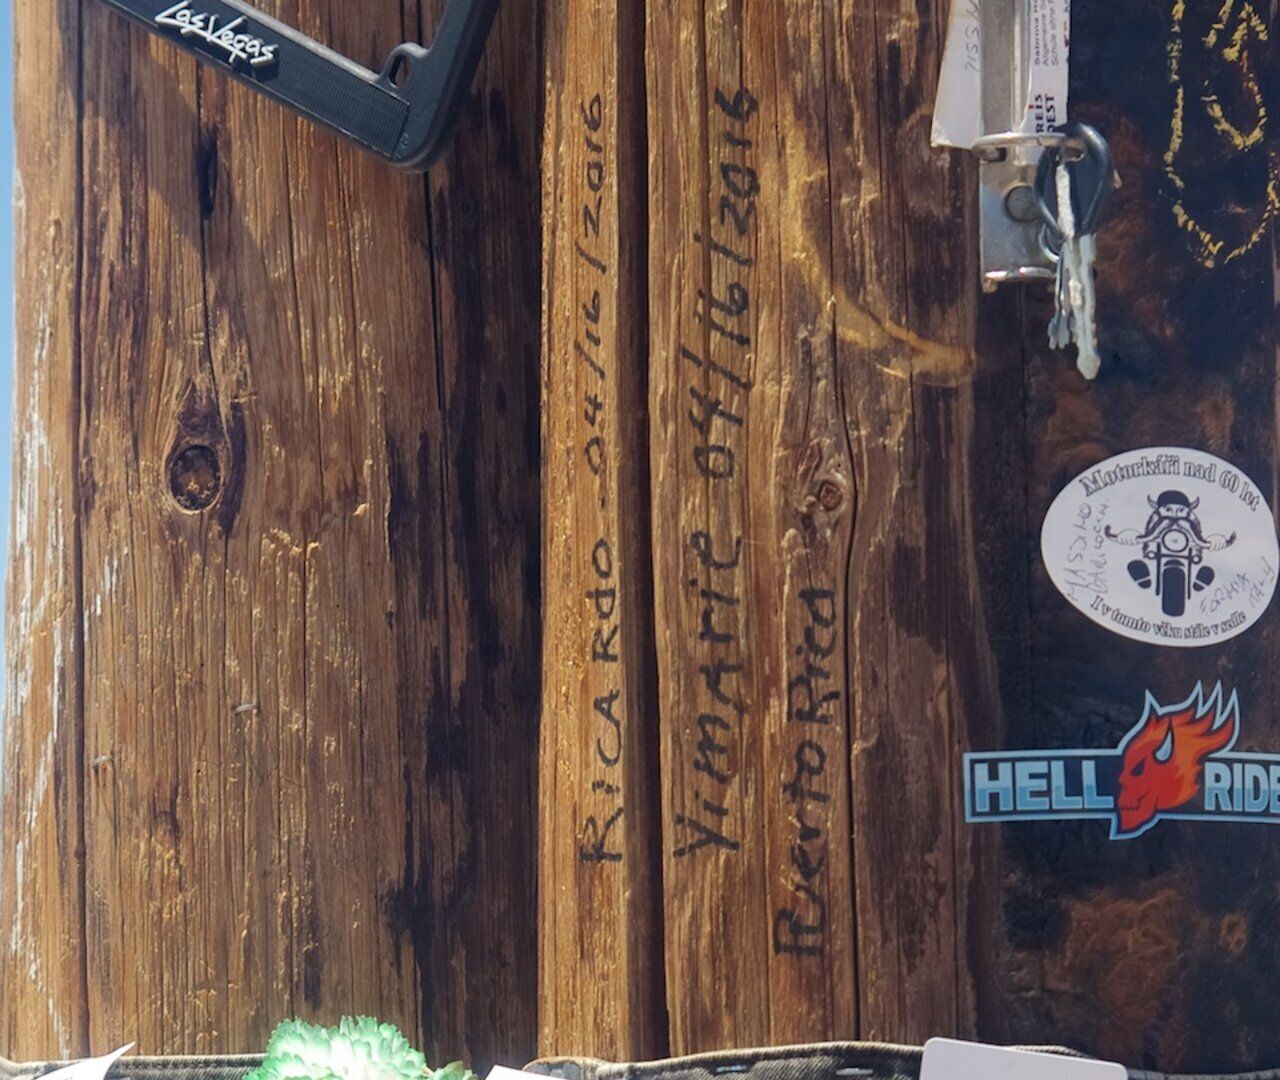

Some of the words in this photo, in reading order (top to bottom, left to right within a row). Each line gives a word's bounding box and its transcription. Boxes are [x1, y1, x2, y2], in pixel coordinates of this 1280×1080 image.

[207, 15, 274, 63] Vegas
[574, 92, 607, 477] 04/16/2016
[680, 86, 761, 480] 04/16/2016
[1183, 460, 1217, 484] nad
[1219, 472, 1240, 494] 60
[1239, 481, 1261, 512] let
[974, 760, 1114, 812] HELL
